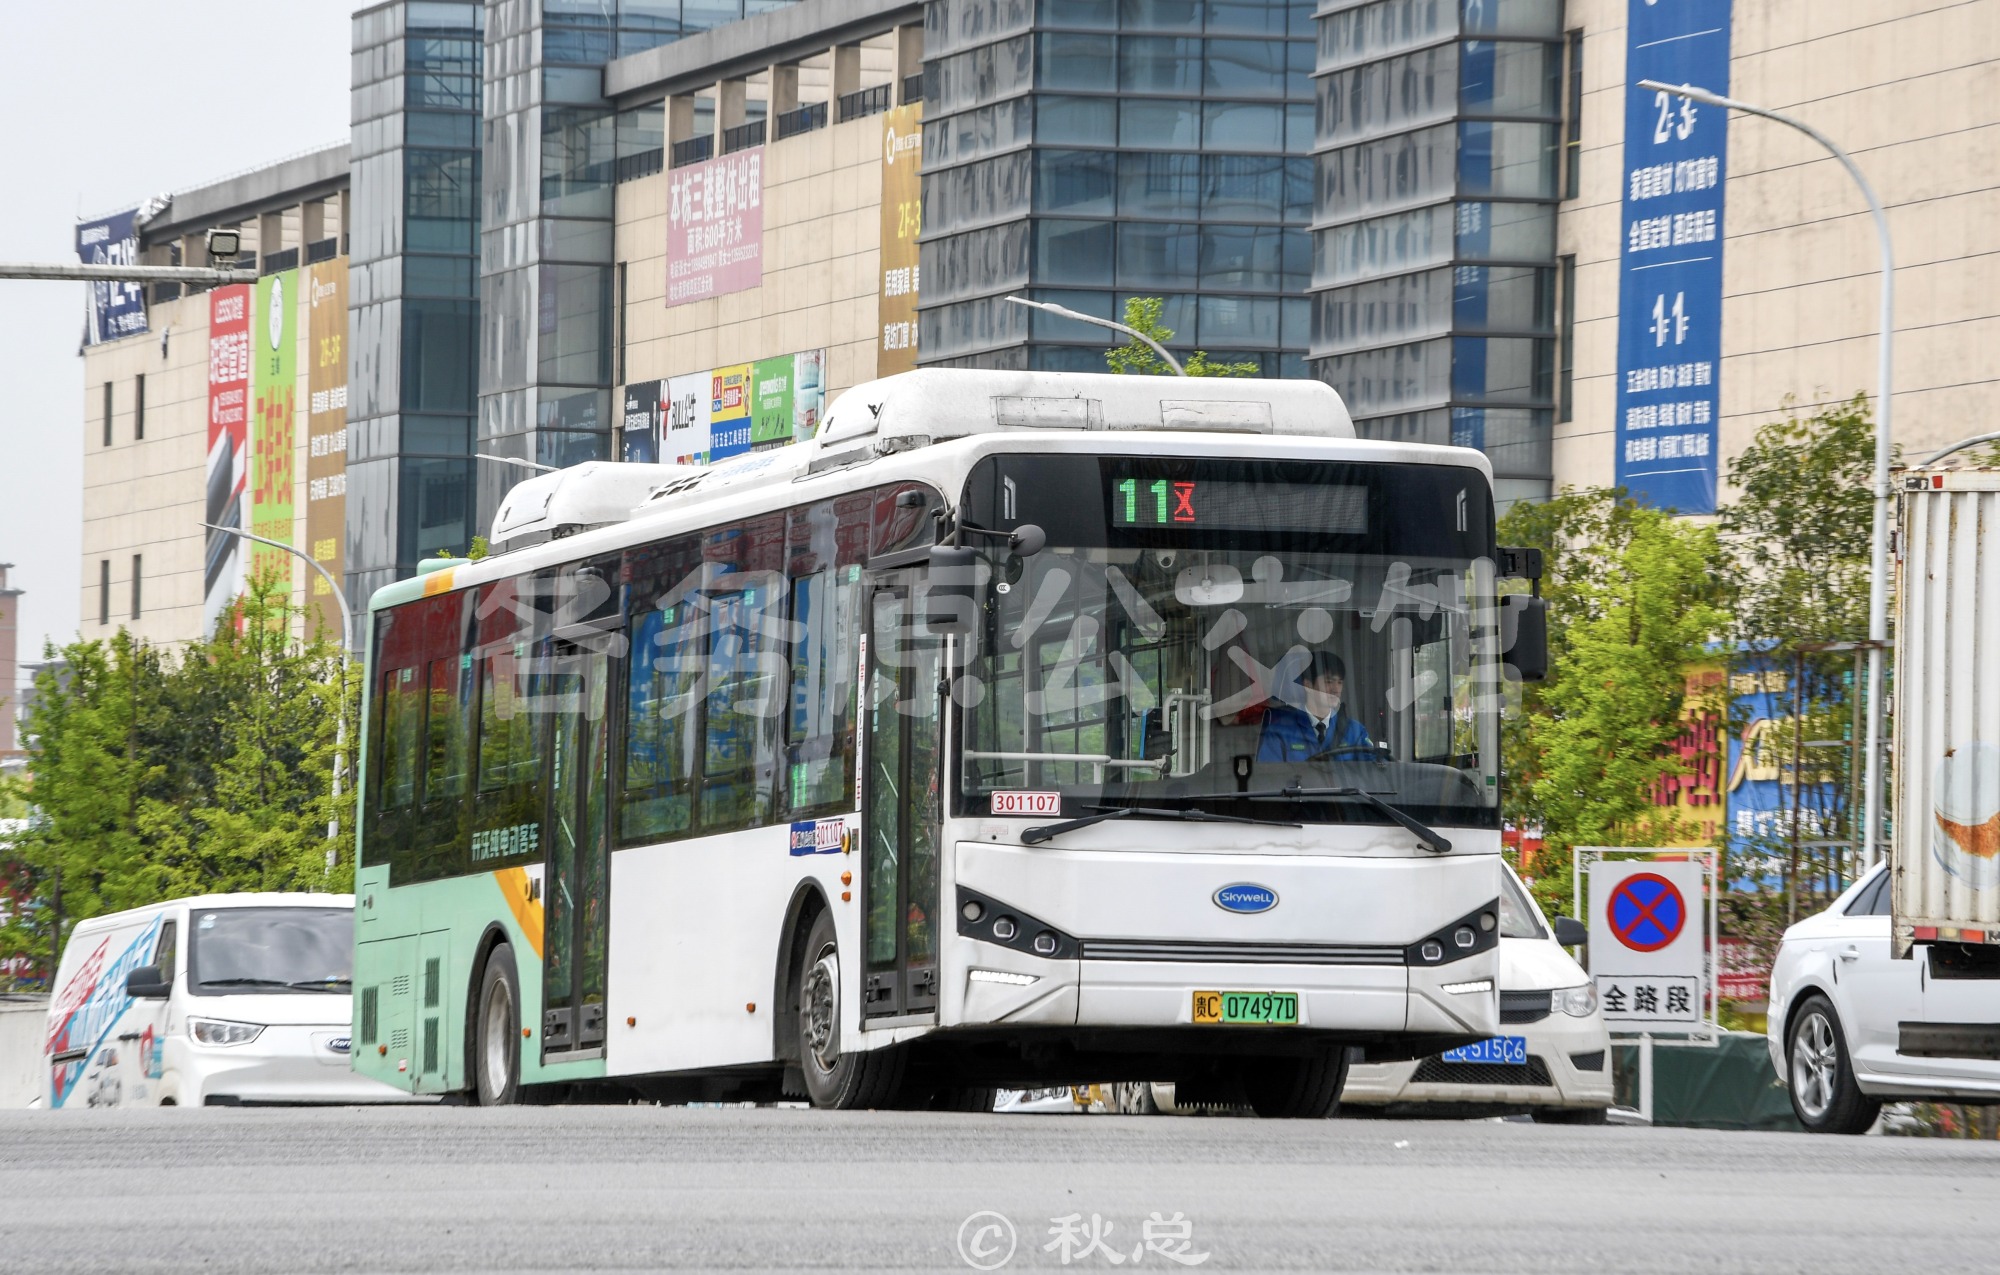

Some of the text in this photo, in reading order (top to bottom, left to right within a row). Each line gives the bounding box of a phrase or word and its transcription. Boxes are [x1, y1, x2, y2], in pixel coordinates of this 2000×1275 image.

[670, 153, 760, 231] 本栋三楼整体出租
[1672, 209, 1716, 247] 酒店用品
[996, 795, 1056, 811] 301107
[471, 822, 540, 862] 开沃纯电动客车
[816, 821, 843, 846] 301107
[1602, 983, 1691, 1015] 全路段
